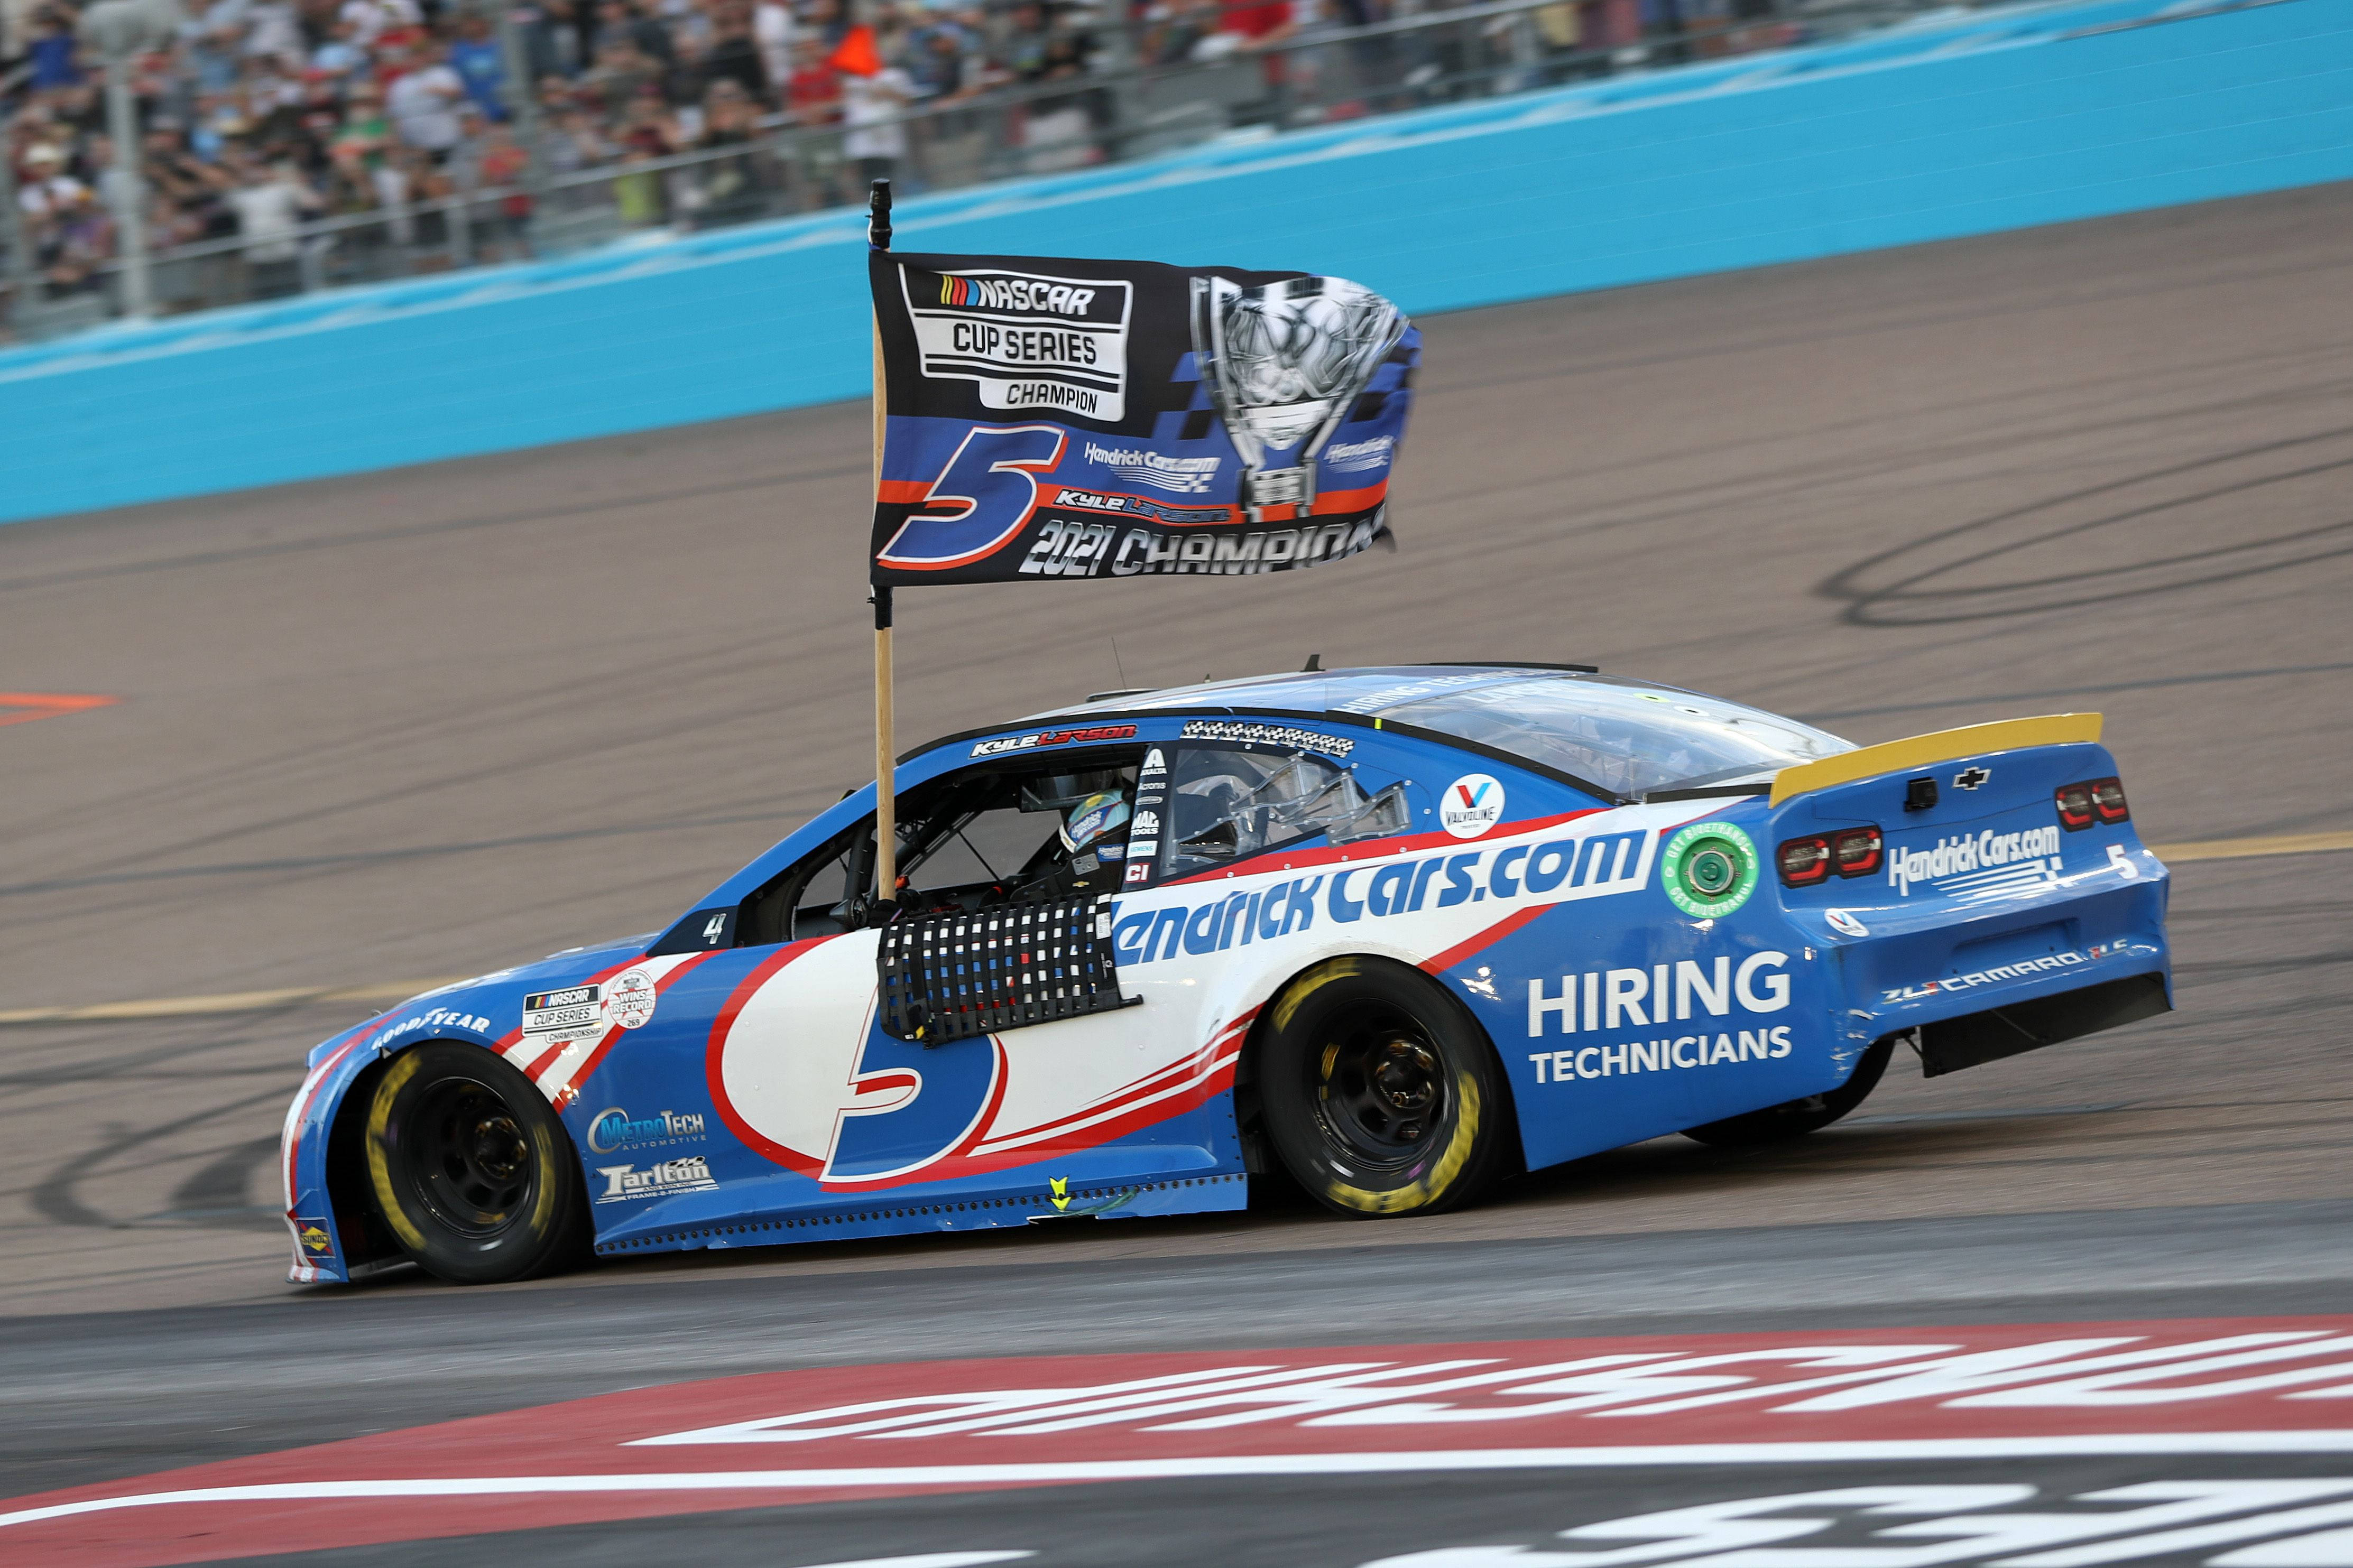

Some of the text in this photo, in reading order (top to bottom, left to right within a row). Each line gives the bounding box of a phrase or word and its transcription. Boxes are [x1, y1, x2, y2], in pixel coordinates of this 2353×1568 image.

[976, 279, 1095, 316] NASCAR
[953, 323, 1096, 365] CUP SERIES
[1006, 383, 1097, 414] CHAMPION
[876, 424, 1069, 571] 5
[1018, 519, 1116, 576] 2021
[1332, 685, 1432, 713] HIRING
[1130, 827, 1159, 836] TOOLS
[1131, 810, 1159, 830] MAC
[1888, 825, 2062, 897] HendrickCars.com
[2105, 844, 2139, 880] 5
[1112, 829, 1649, 965] endrickCars.com
[702, 913, 727, 945] 4
[1939, 951, 2084, 992] CAMARO
[548, 989, 590, 1007] NASCAR
[613, 1000, 652, 1014] RECORD
[619, 990, 647, 1003] WINS
[1527, 950, 1791, 1038] HIRING
[371, 1006, 491, 1051] GOODYEAR
[534, 1007, 590, 1025] CUP SERIES
[549, 1027, 601, 1042] CHAMPIONSHIP
[1528, 1026, 1793, 1084] TECHNICIANS
[622, 1134, 707, 1151] AUTOMOTIVE
[596, 1162, 712, 1197] Tarlton
